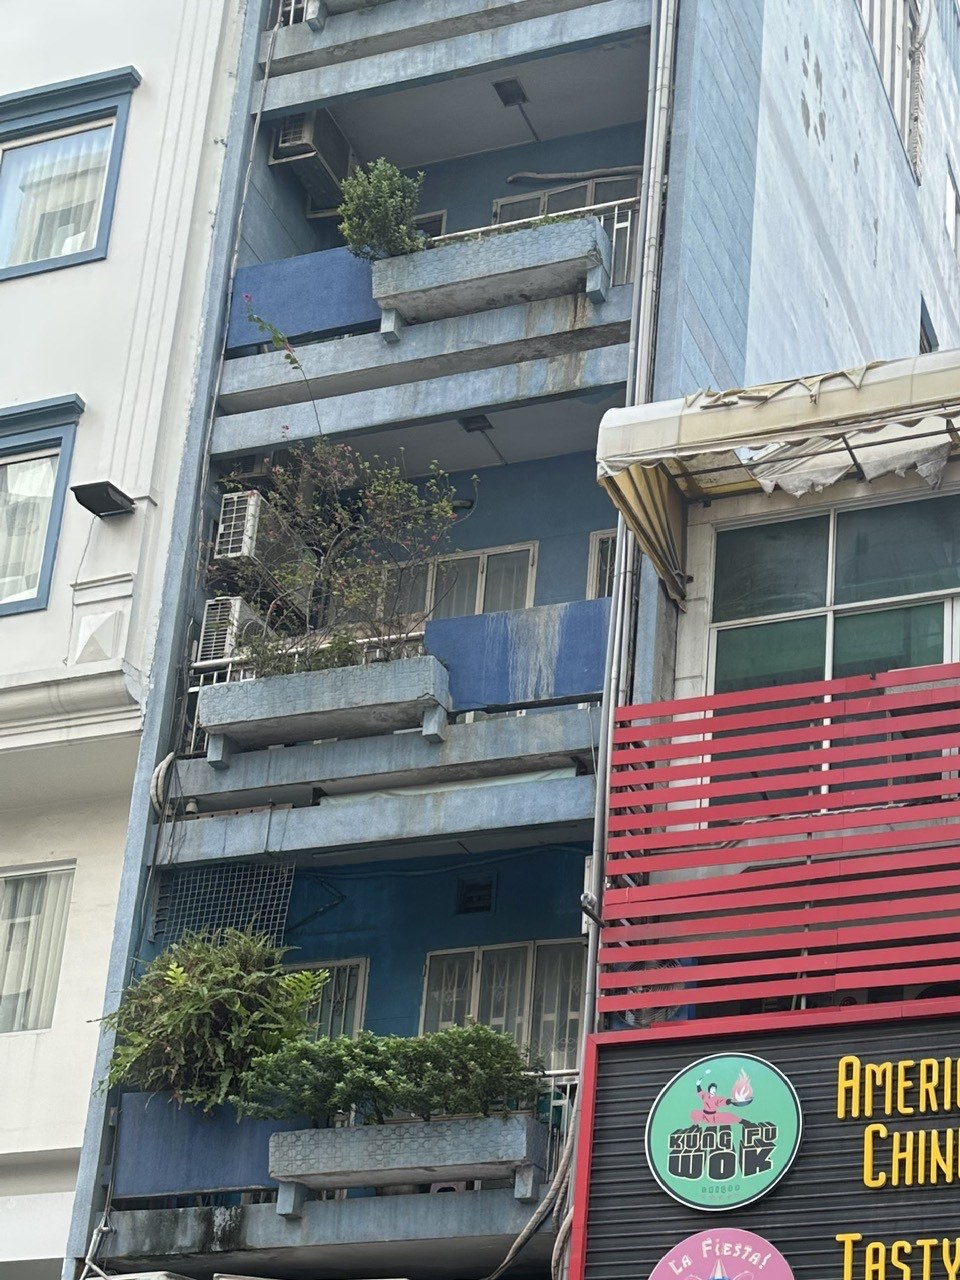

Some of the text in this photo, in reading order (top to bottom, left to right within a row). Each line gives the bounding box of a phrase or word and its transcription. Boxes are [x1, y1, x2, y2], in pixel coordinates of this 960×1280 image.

[668, 1122, 779, 1151] KUNG FU
[667, 1145, 776, 1180] WOK
